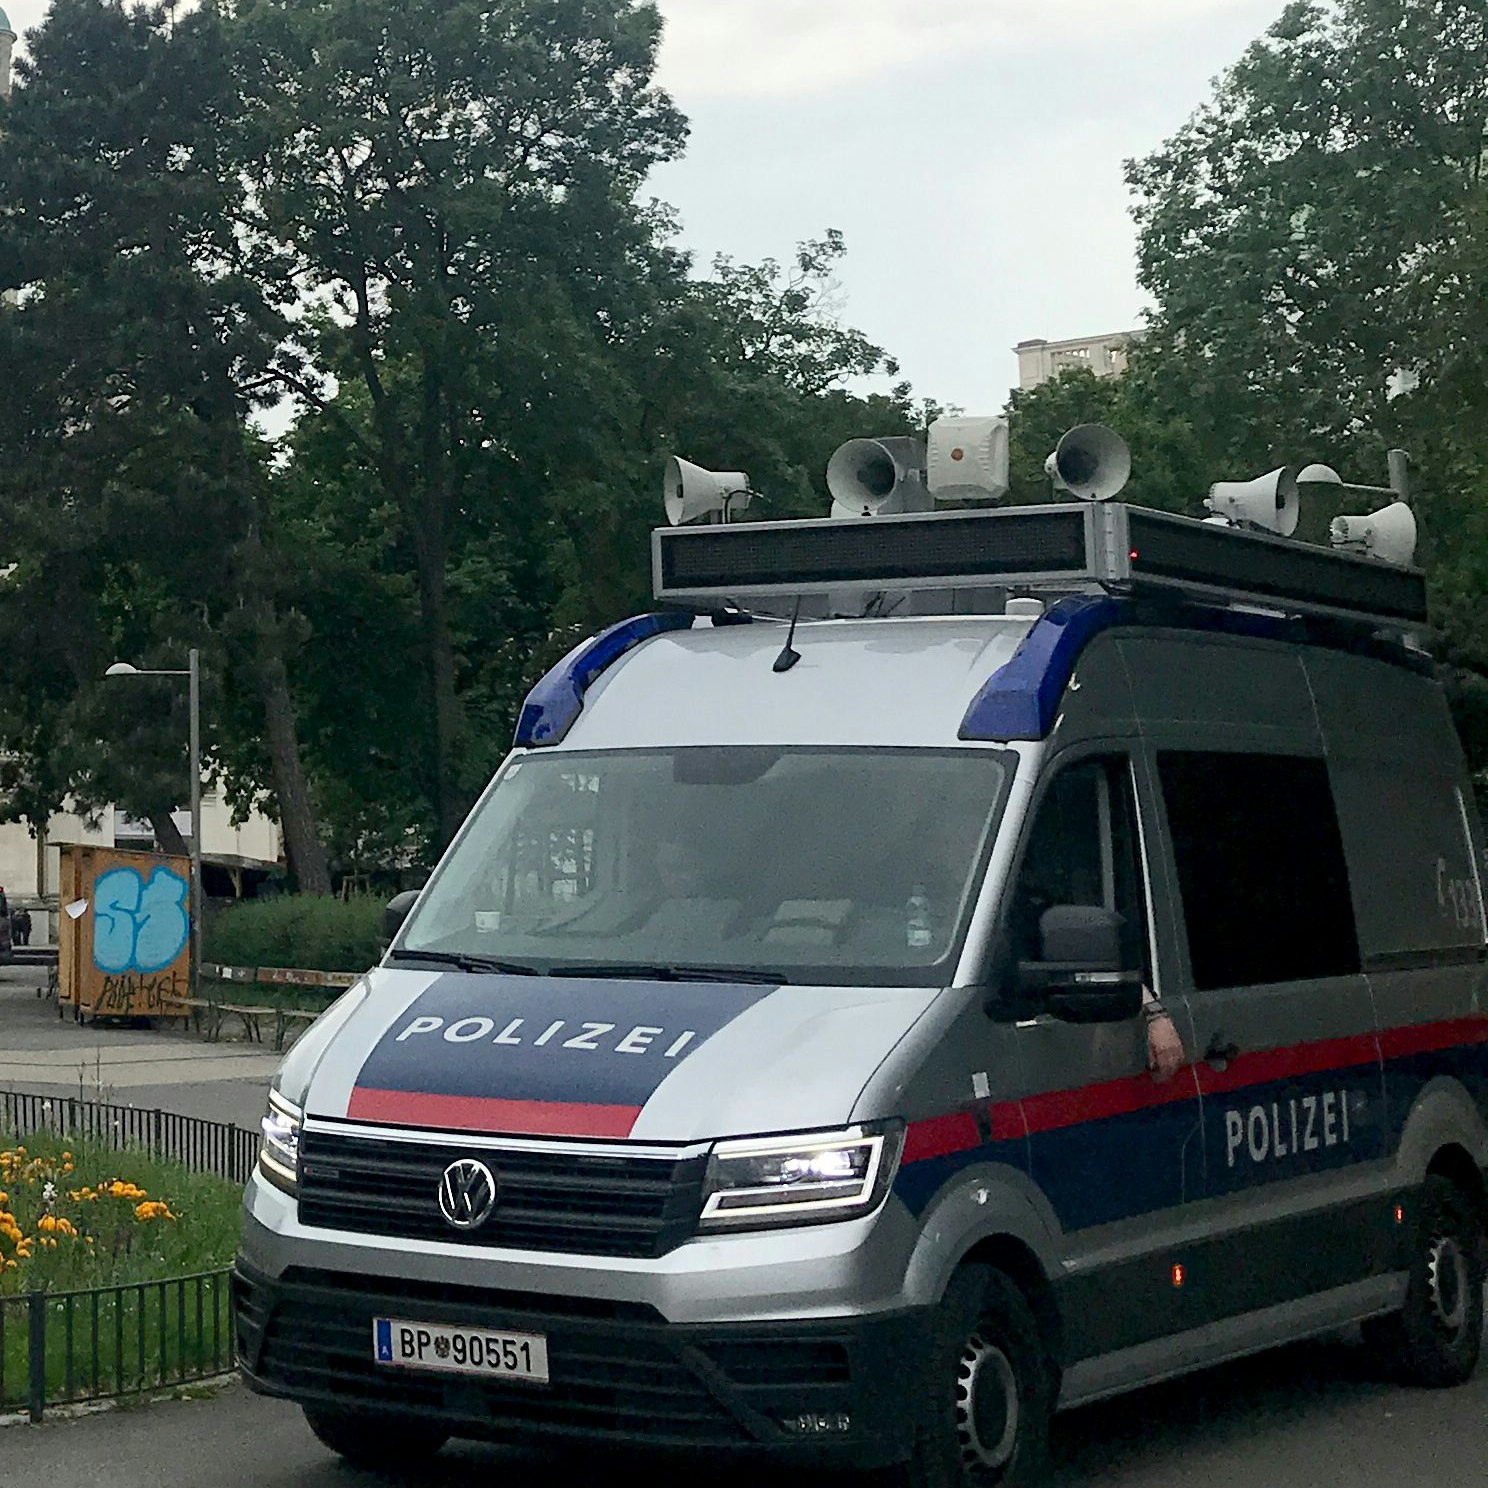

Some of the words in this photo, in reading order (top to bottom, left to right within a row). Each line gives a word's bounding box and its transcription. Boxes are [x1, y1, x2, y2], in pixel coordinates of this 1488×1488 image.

[396, 1016, 696, 1057] POLIZEI
[1225, 1089, 1349, 1168] POLIZEI
[452, 1333, 532, 1372] 90551
